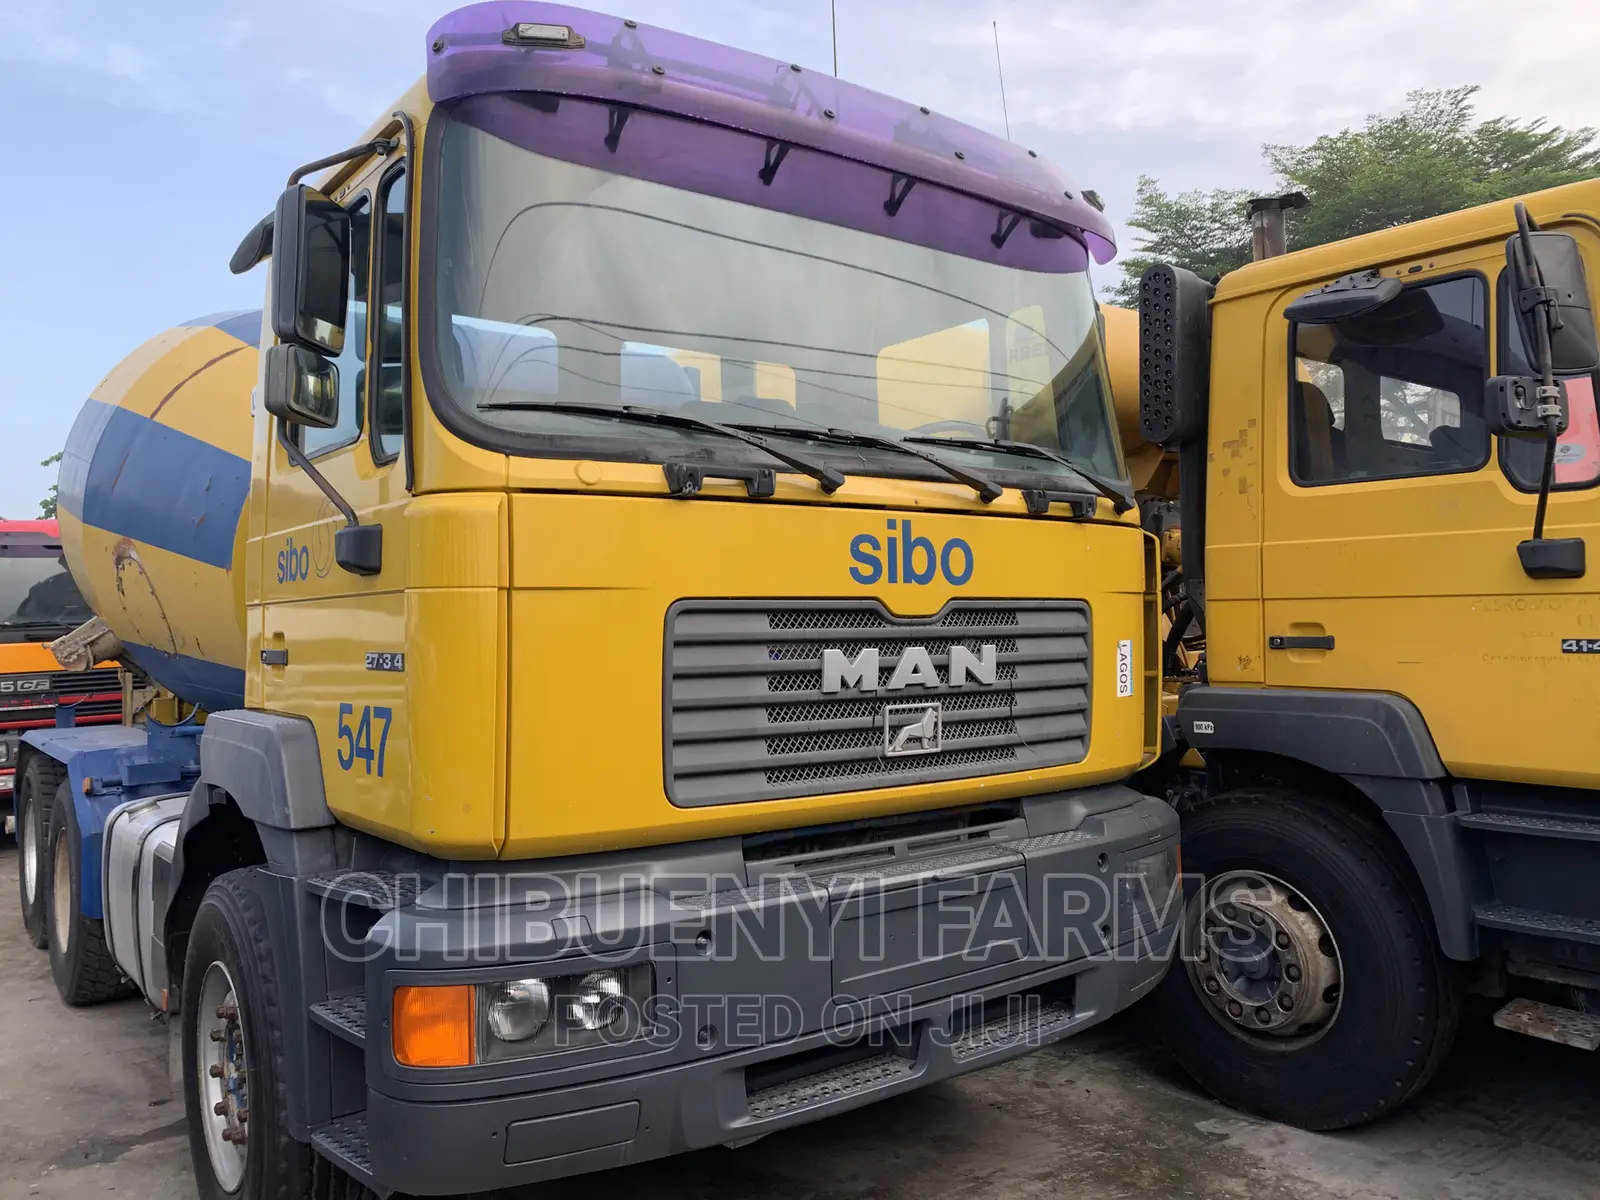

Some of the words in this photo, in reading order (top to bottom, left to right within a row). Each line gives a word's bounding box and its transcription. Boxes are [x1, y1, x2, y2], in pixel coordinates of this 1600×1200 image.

[277, 536, 309, 584] sibo
[849, 519, 974, 586] sibo
[821, 644, 997, 694] MAN
[1118, 643, 1128, 694] LAGOS
[337, 702, 392, 777] 547
